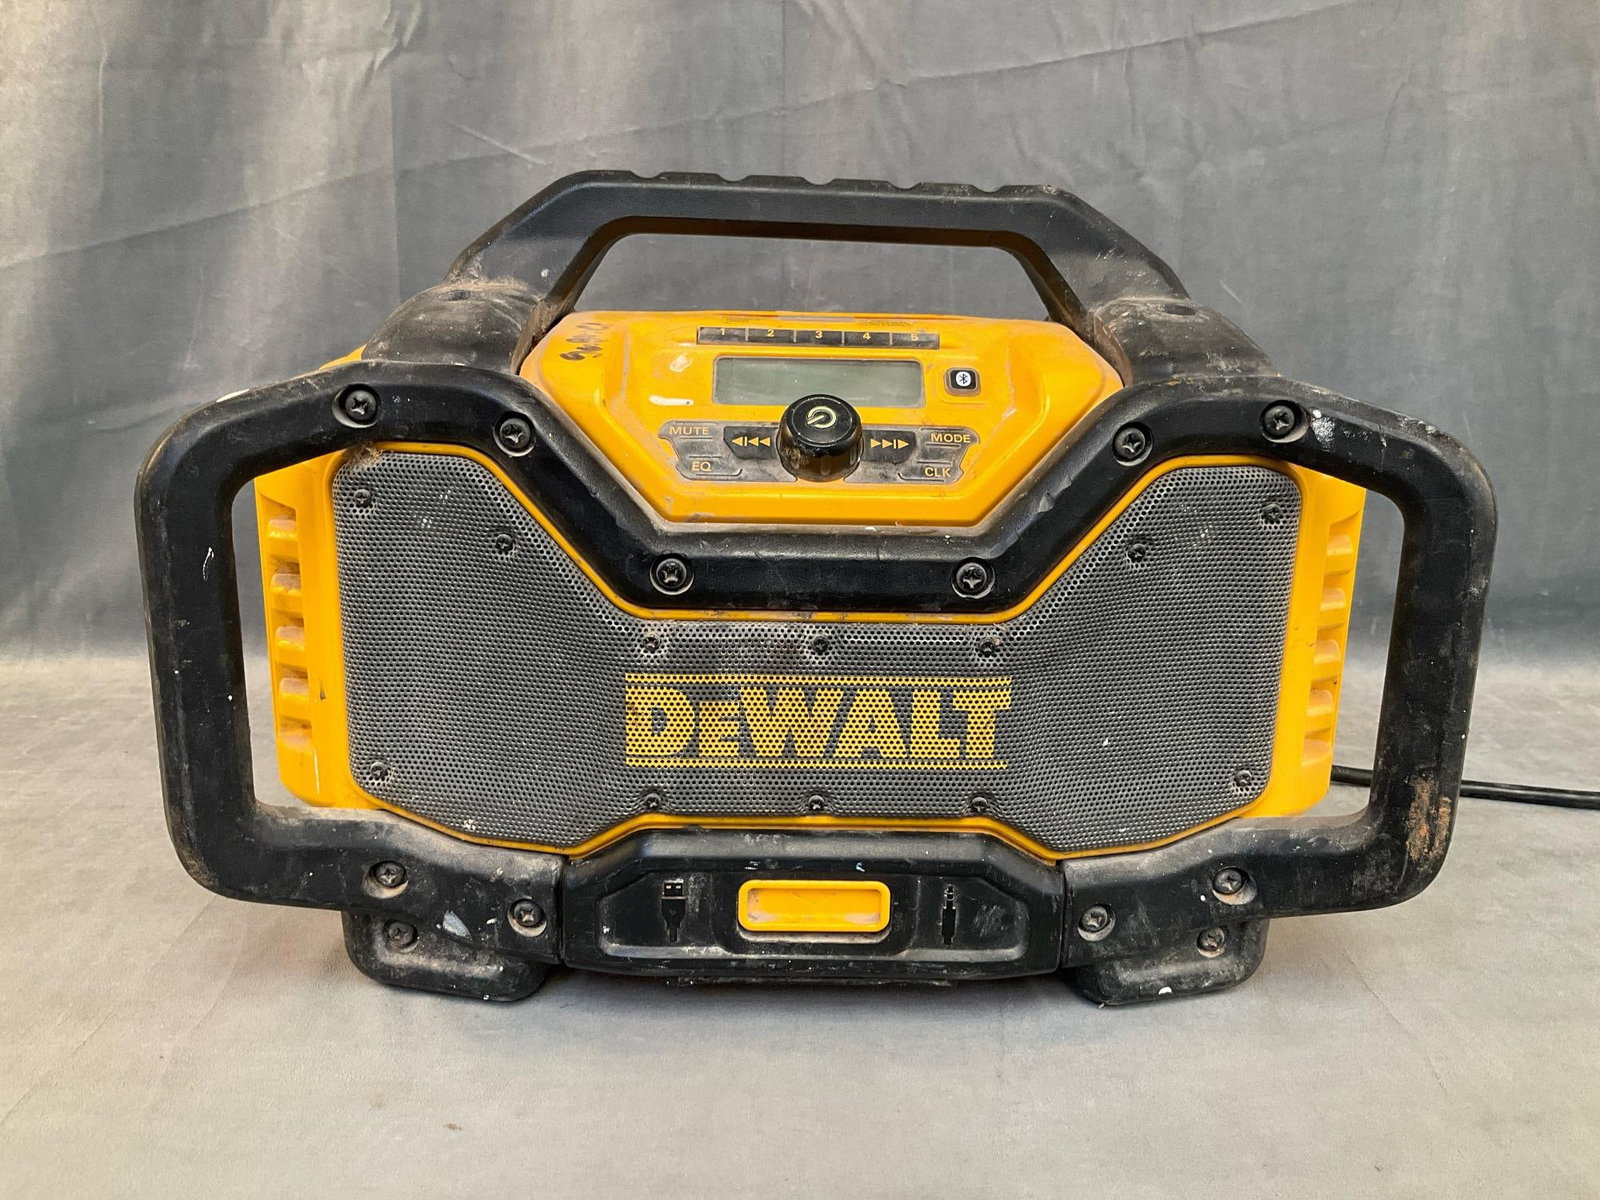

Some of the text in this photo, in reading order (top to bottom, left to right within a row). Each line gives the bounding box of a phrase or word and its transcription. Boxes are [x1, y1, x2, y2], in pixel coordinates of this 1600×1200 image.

[719, 328, 919, 342] 1 2 3 4 5
[668, 426, 710, 436] MUTE
[930, 433, 971, 444] MODE
[691, 461, 712, 472] EQ
[924, 466, 952, 478] CLK
[625, 685, 1012, 760] DEWALT
